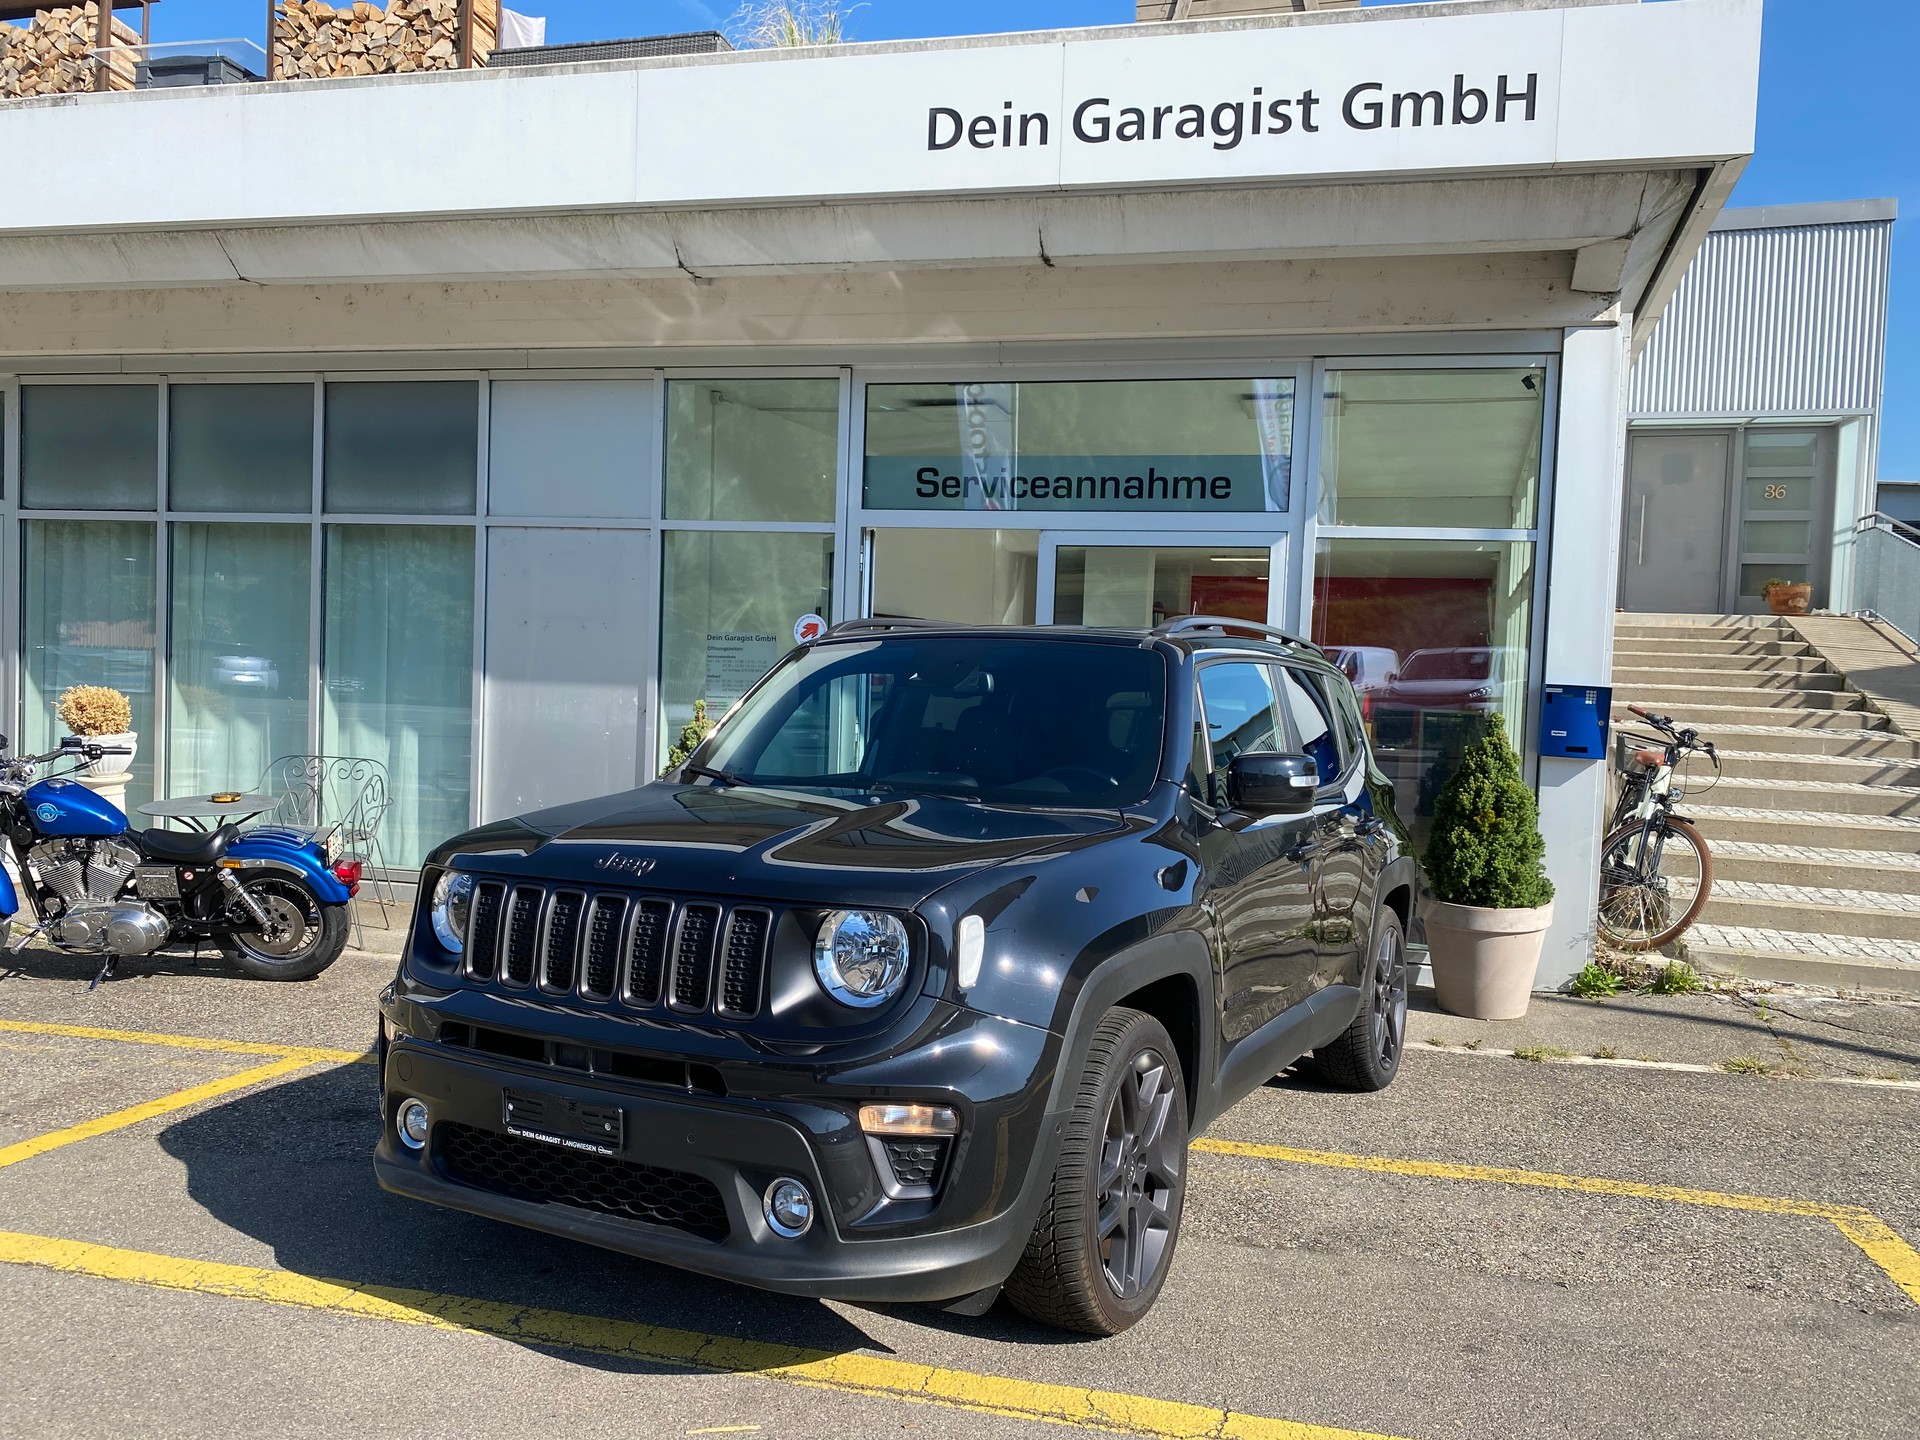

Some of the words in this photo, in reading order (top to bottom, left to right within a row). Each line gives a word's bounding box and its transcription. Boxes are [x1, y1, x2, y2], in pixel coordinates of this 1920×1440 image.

[927, 101, 1050, 151] Dein
[1072, 86, 1320, 151] Garagist
[1341, 73, 1538, 131] GmbH
[916, 467, 1232, 500] Serviceannahme
[1764, 484, 1787, 499] 36
[724, 634, 754, 643] Garagist
[593, 851, 657, 877] Jeep
[522, 1130, 535, 1140] DEIN
[535, 1133, 561, 1145] GARAGIST
[562, 1139, 597, 1153] LANGWIESEN
